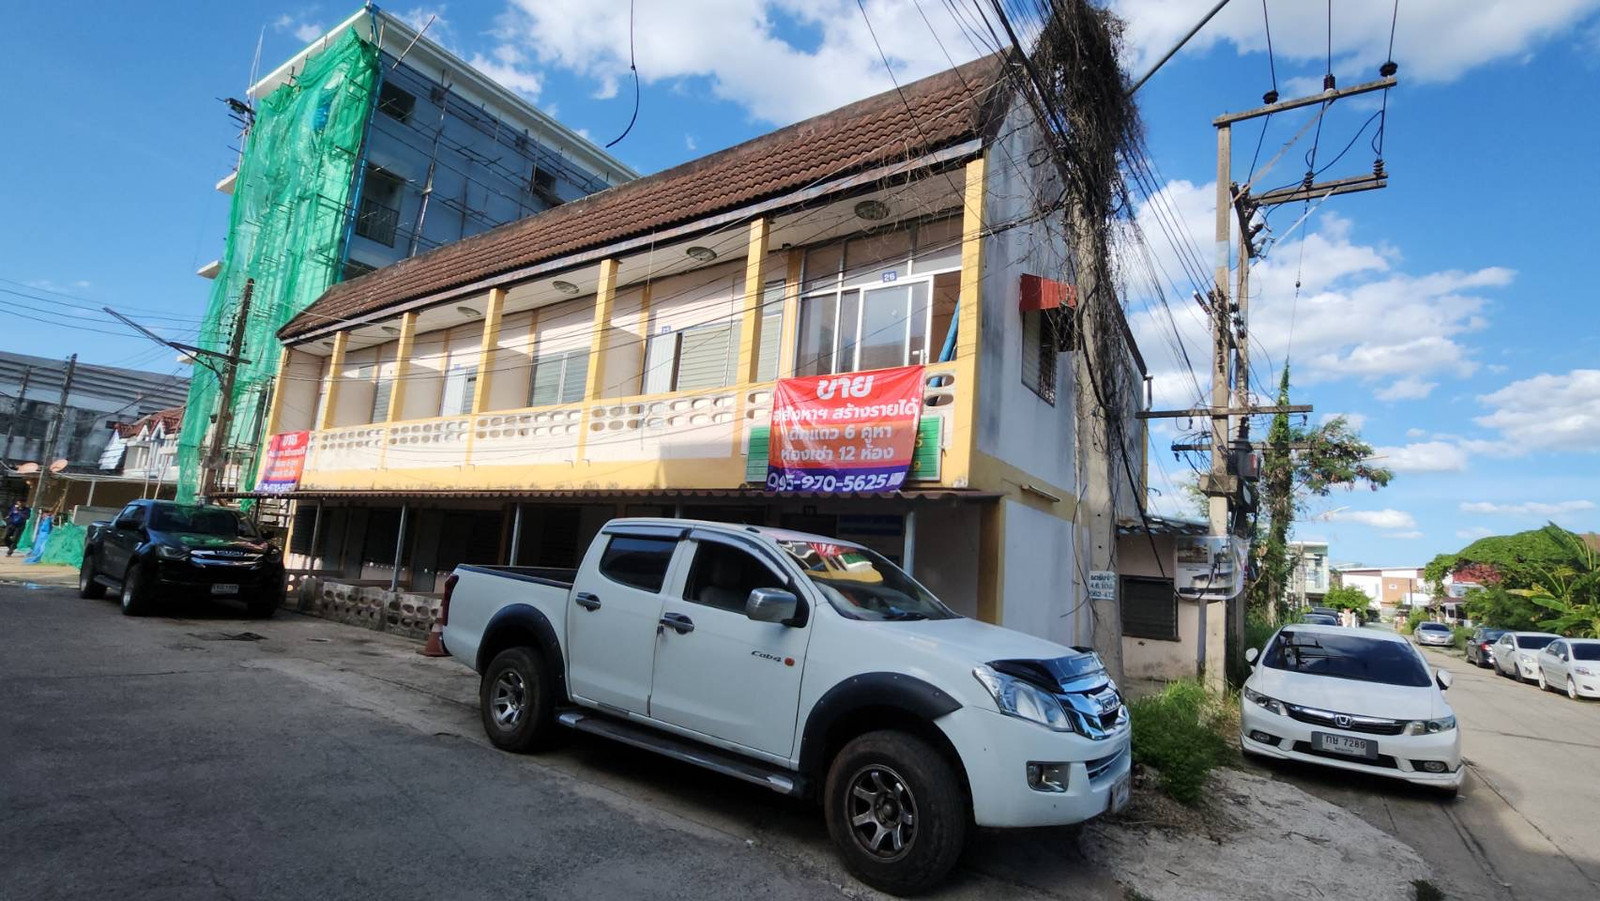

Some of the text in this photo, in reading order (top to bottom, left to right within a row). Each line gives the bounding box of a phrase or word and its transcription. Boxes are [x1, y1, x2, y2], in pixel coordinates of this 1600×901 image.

[816, 375, 874, 400] ขาย
[832, 398, 919, 420] สร้างรายได้
[844, 425, 856, 439] 6
[861, 425, 893, 445] คูหา
[839, 446, 855, 461] 12
[860, 444, 894, 461] ห้อง
[767, 473, 888, 491] 095-970-5625
[1343, 738, 1366, 749] 7289
